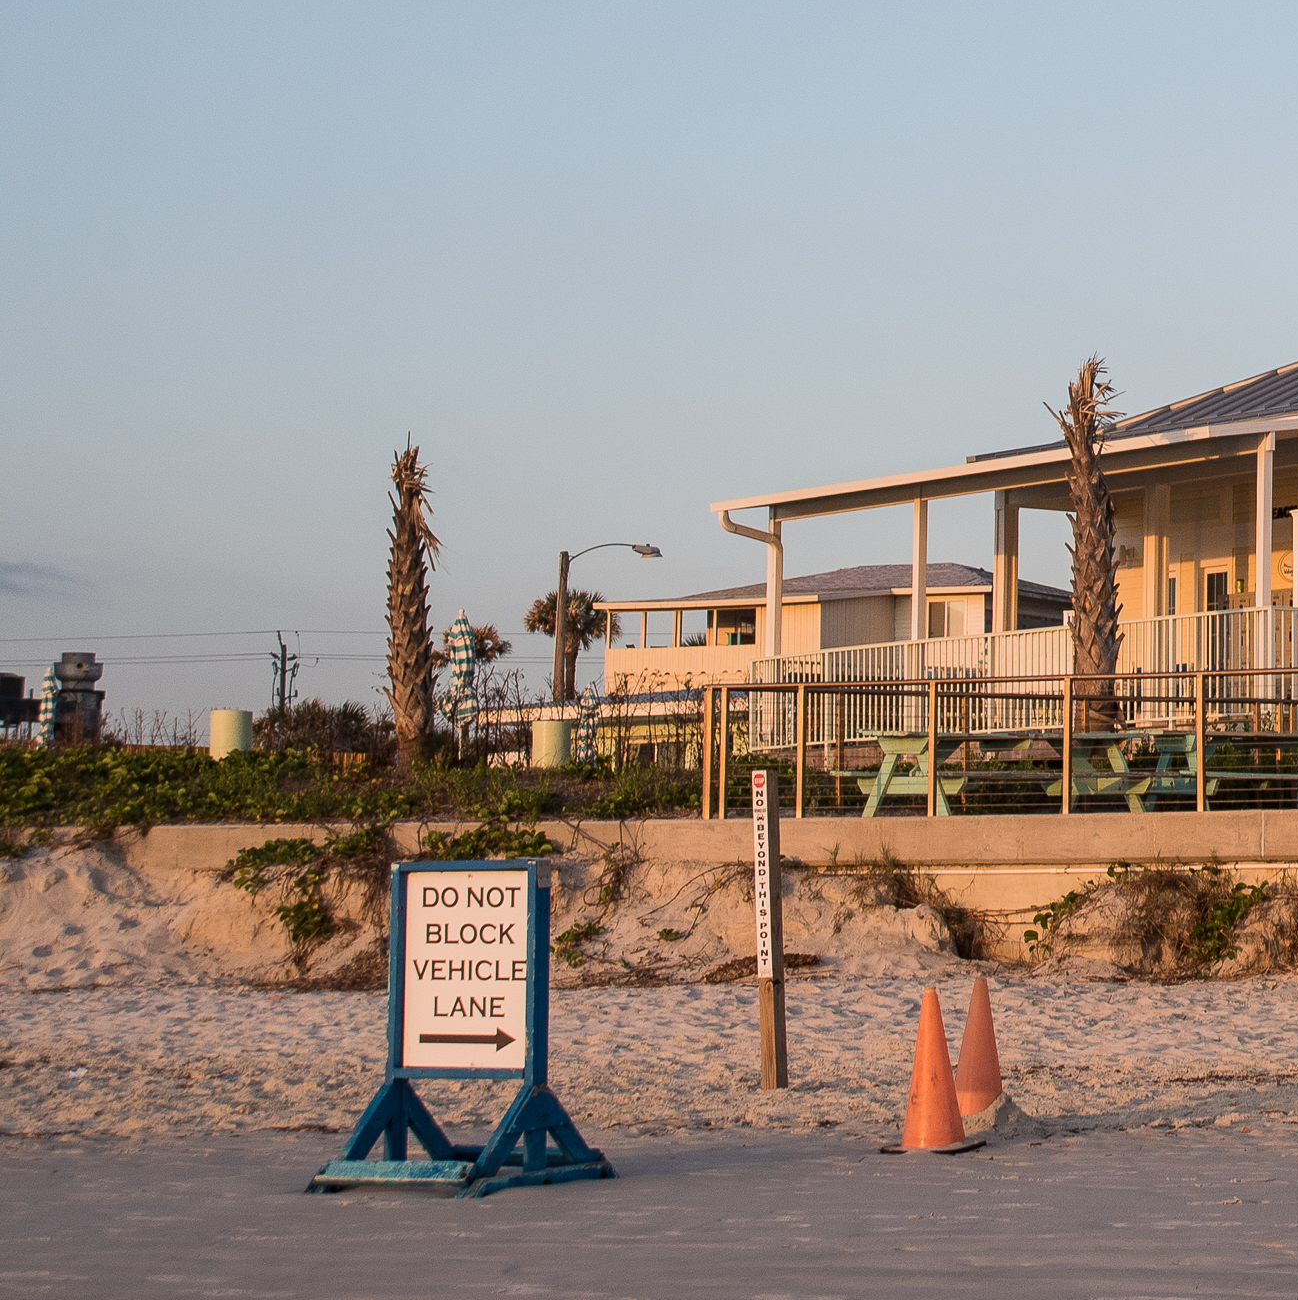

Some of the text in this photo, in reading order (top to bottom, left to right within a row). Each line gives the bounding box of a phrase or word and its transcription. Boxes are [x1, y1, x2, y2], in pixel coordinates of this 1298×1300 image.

[755, 790, 764, 807] NO
[757, 824, 767, 877] BEYOND
[421, 886, 521, 908] DO NOT
[759, 882, 768, 917] THIS
[425, 922, 516, 945] BLOCK
[760, 922, 769, 966] POINT
[412, 959, 527, 981] VEHICLE
[433, 996, 506, 1018] LANE
